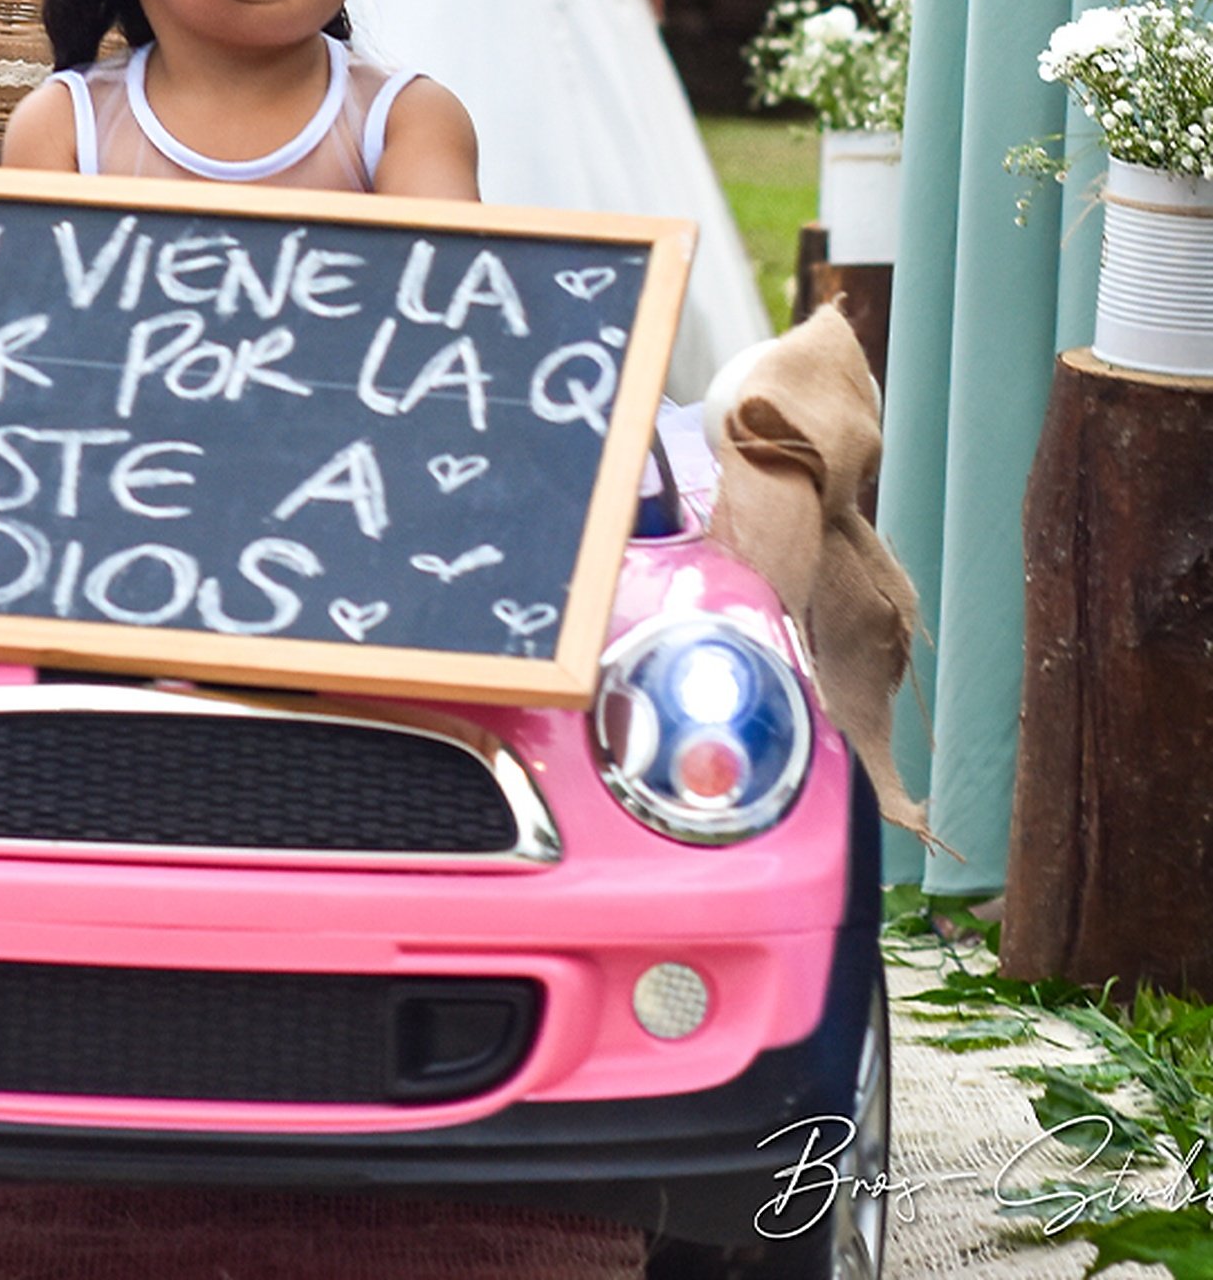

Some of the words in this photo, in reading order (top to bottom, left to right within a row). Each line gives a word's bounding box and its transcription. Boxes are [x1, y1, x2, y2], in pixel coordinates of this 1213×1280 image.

[53, 215, 366, 317] VIENE
[396, 240, 528, 335] LA
[117, 310, 311, 417] POR
[358, 318, 491, 430] LA
[273, 440, 390, 538] A
